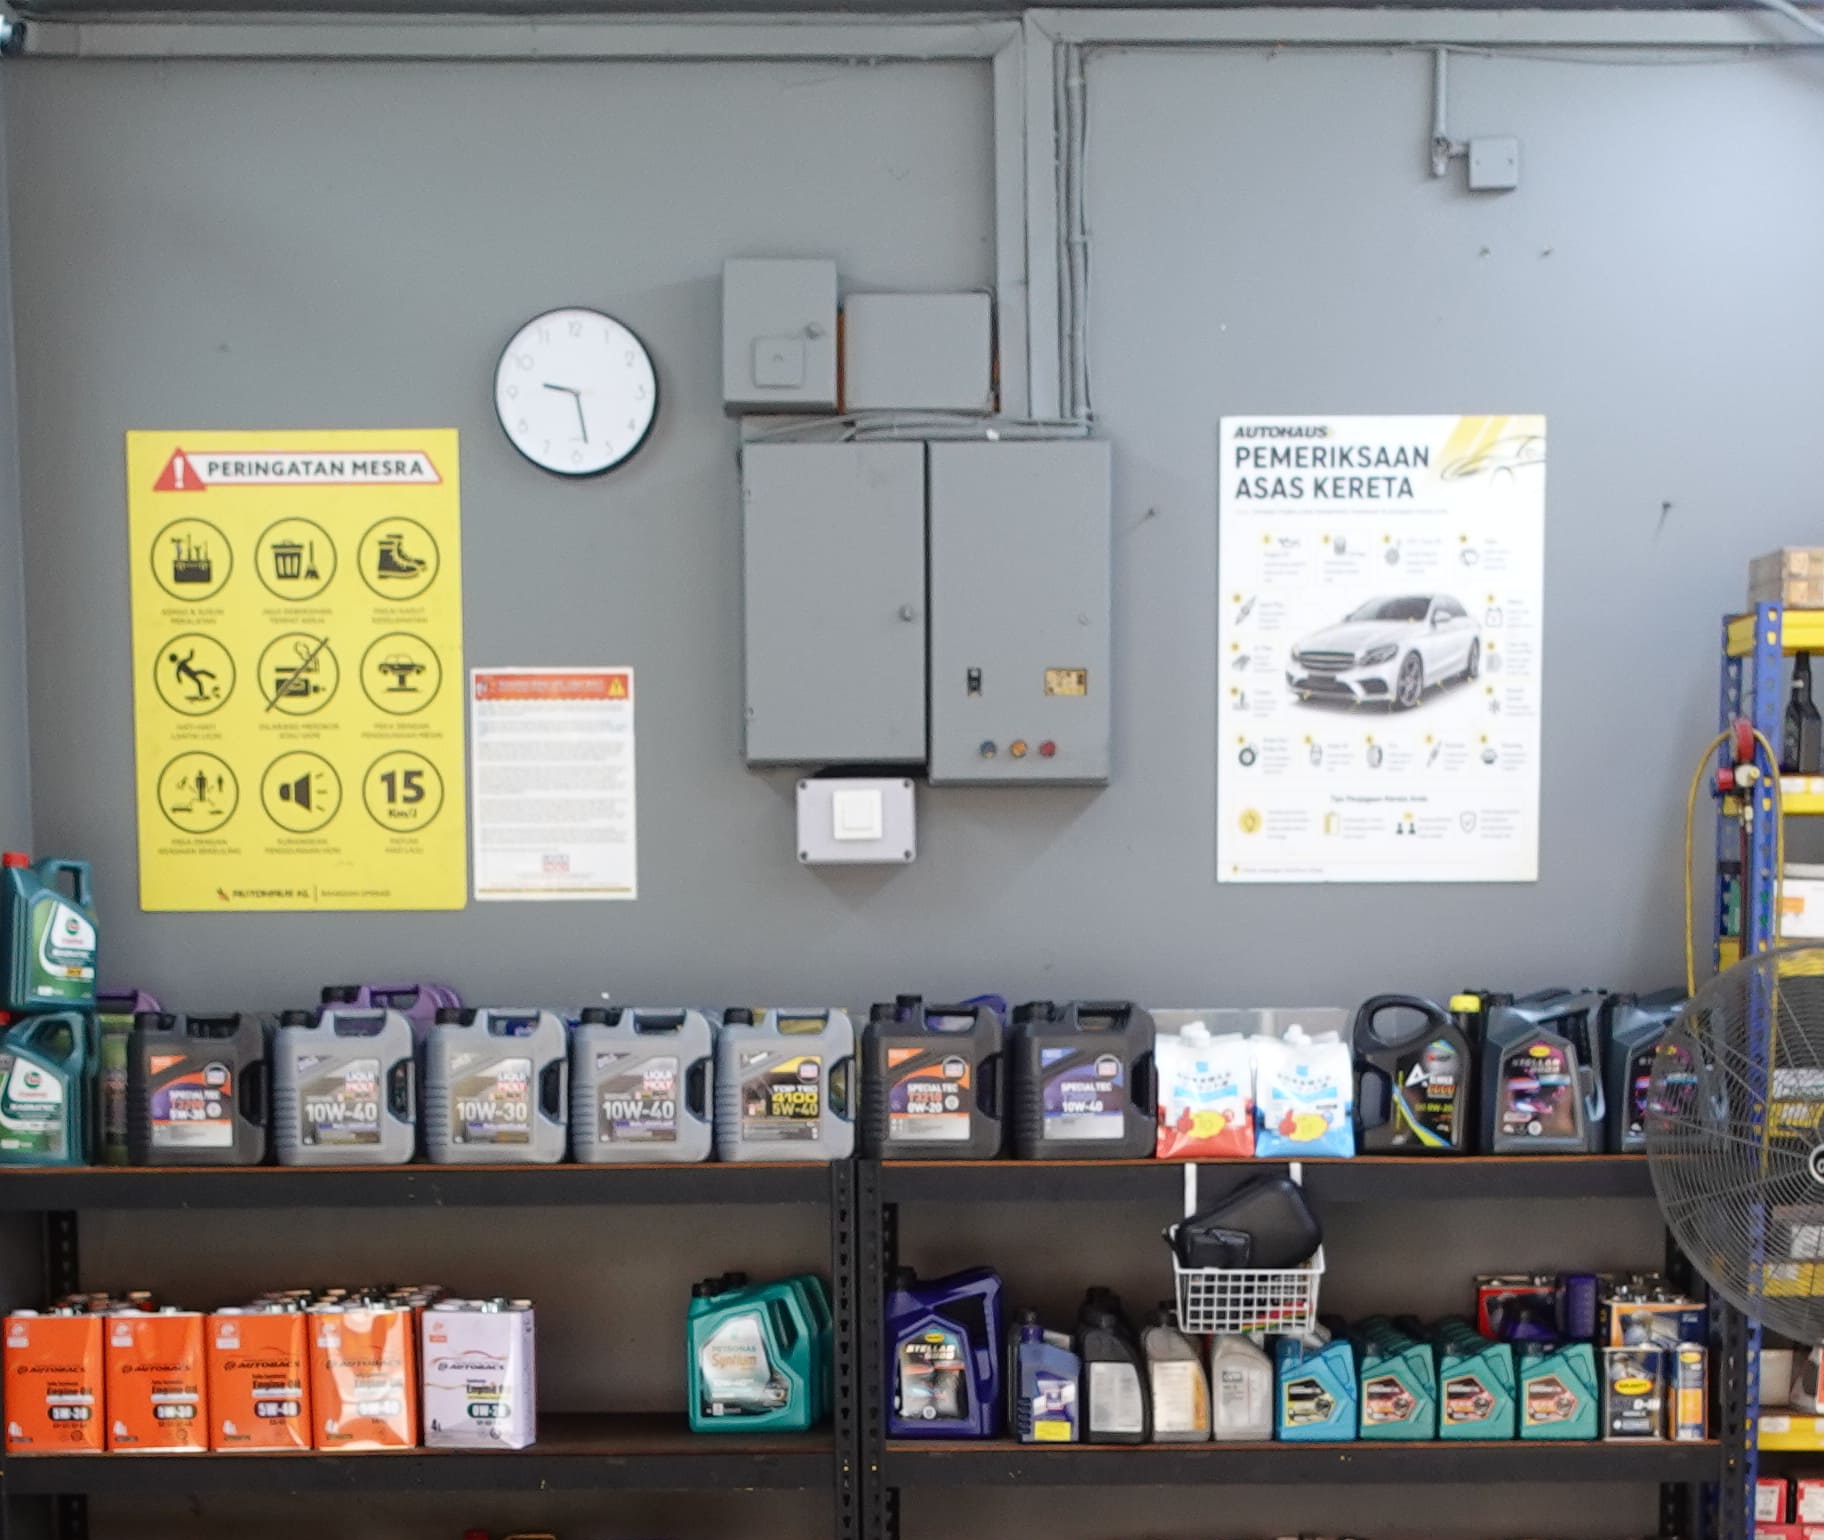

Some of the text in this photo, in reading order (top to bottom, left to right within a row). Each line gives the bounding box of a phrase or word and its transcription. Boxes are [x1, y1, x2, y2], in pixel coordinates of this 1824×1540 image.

[1234, 425, 1328, 439] AUTOHAUS
[1235, 446, 1429, 469] PEMERIKSAAN
[208, 460, 424, 477] PERINGATAN MESRA
[1235, 476, 1415, 499] ASAS KERETA
[380, 770, 425, 804] 15
[305, 1102, 377, 1122] 10W-40
[457, 1102, 528, 1121] 10W-30
[603, 1101, 675, 1119] 10W-40
